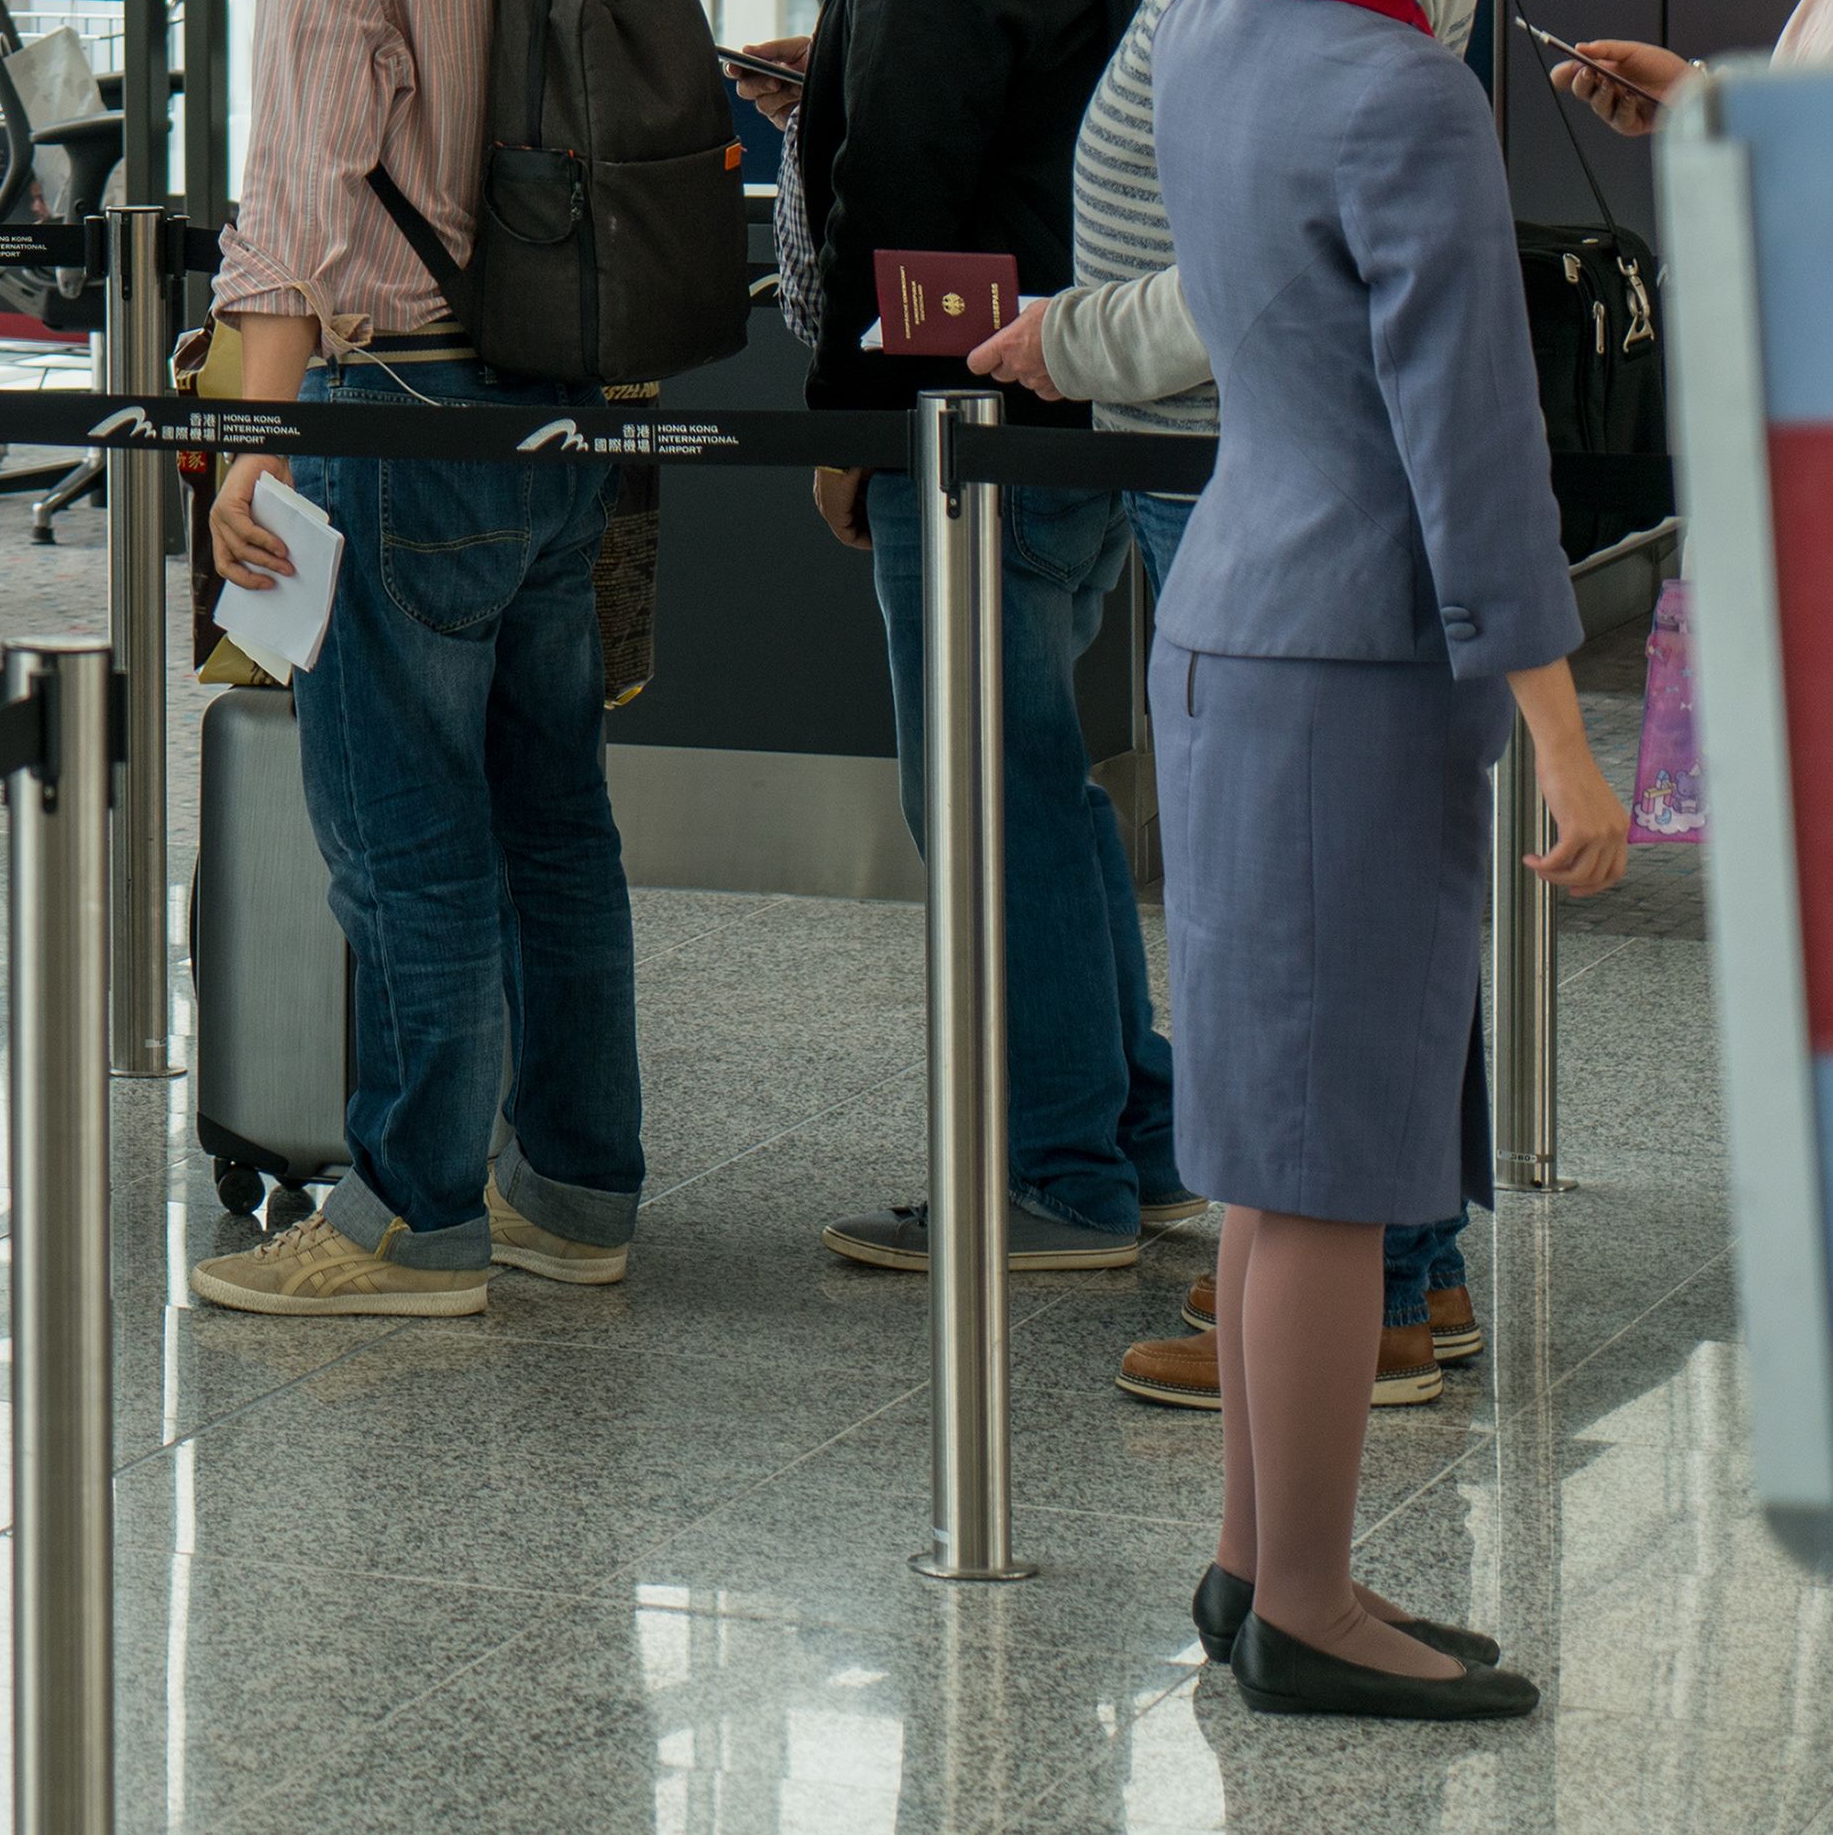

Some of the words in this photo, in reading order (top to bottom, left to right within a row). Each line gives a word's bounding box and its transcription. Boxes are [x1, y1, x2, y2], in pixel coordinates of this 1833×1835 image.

[11, 235, 33, 243] KONG
[991, 283, 1000, 329] REISEPASS
[190, 412, 215, 427] 香港
[223, 414, 251, 423] HONG
[254, 415, 281, 424] KONG
[223, 424, 300, 436] INTERNATIONAL
[623, 424, 650, 439] 香港
[658, 424, 687, 433] HONG
[689, 425, 719, 434] KONG
[223, 435, 265, 444] AIRPORT
[658, 434, 740, 445] INTERNATIONAL
[658, 445, 703, 454] AIRPORT
